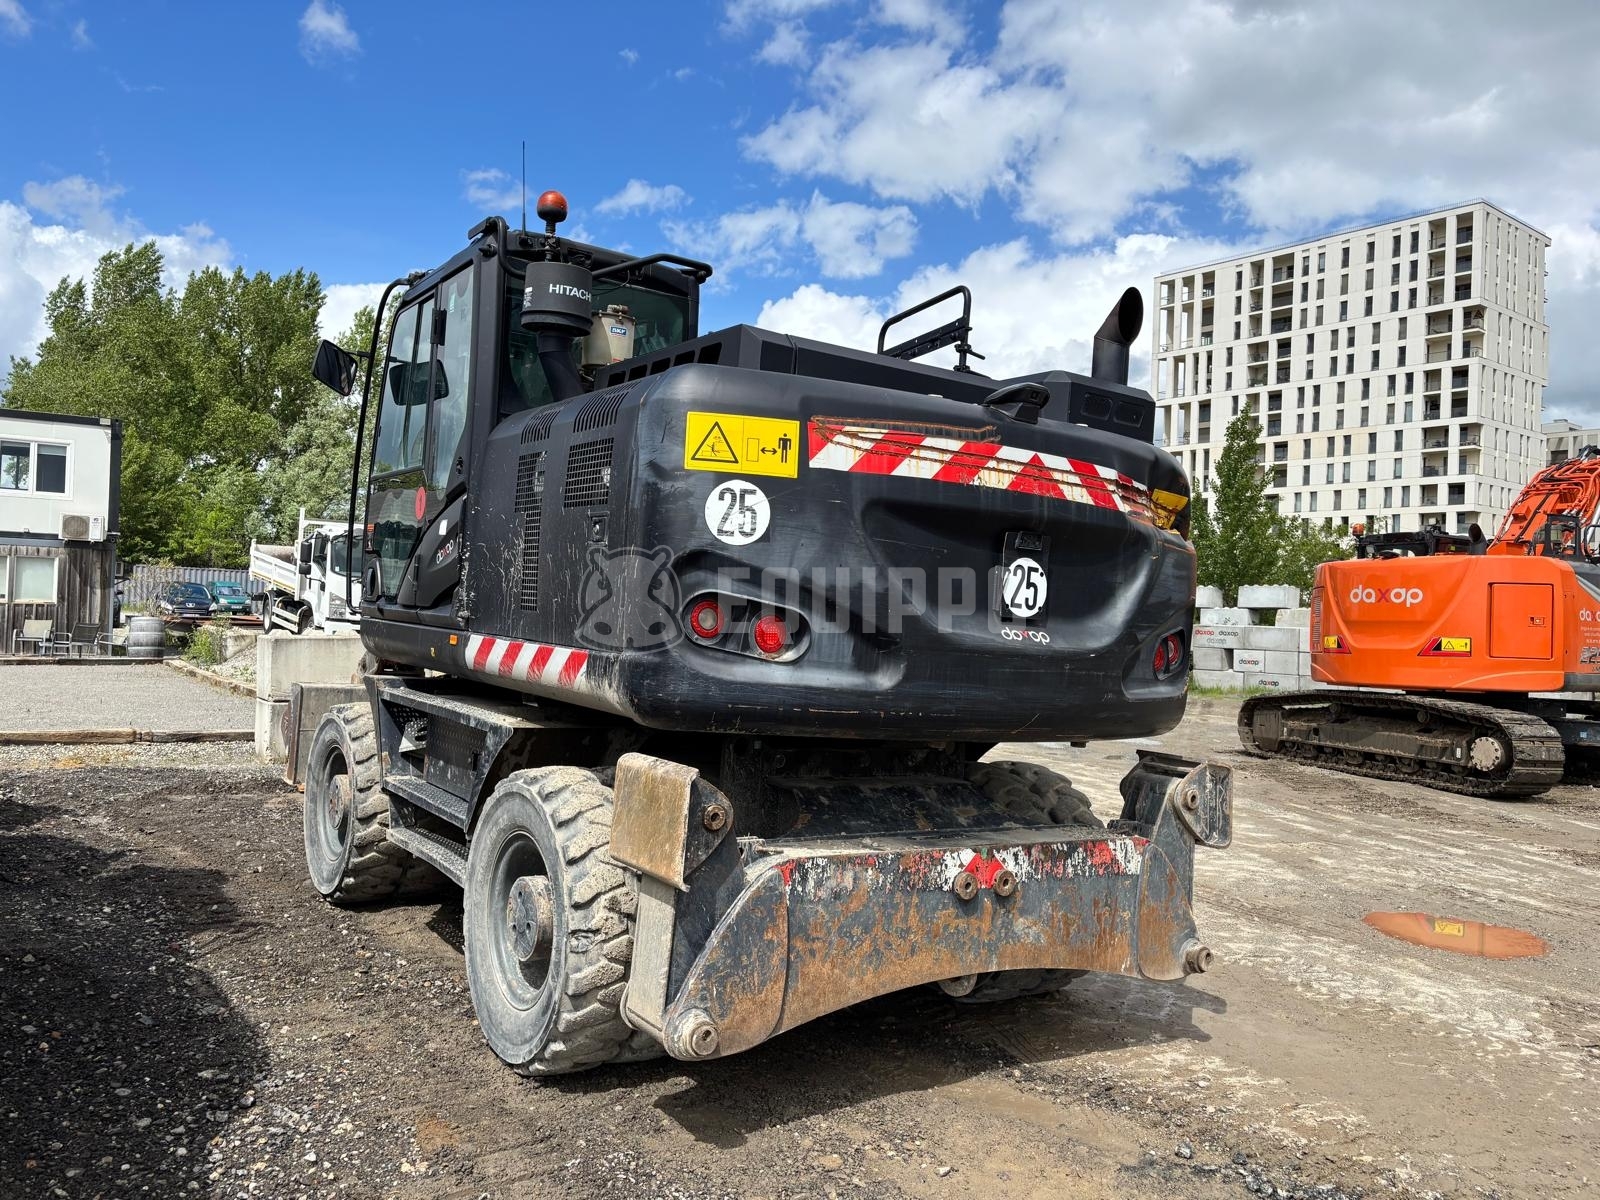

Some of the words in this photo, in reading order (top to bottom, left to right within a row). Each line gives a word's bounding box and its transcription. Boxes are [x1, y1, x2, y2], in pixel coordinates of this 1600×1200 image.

[549, 283, 592, 302] HITACH
[716, 486, 757, 538] 25
[1010, 564, 1040, 611] 25
[1350, 584, 1424, 608] daxap
